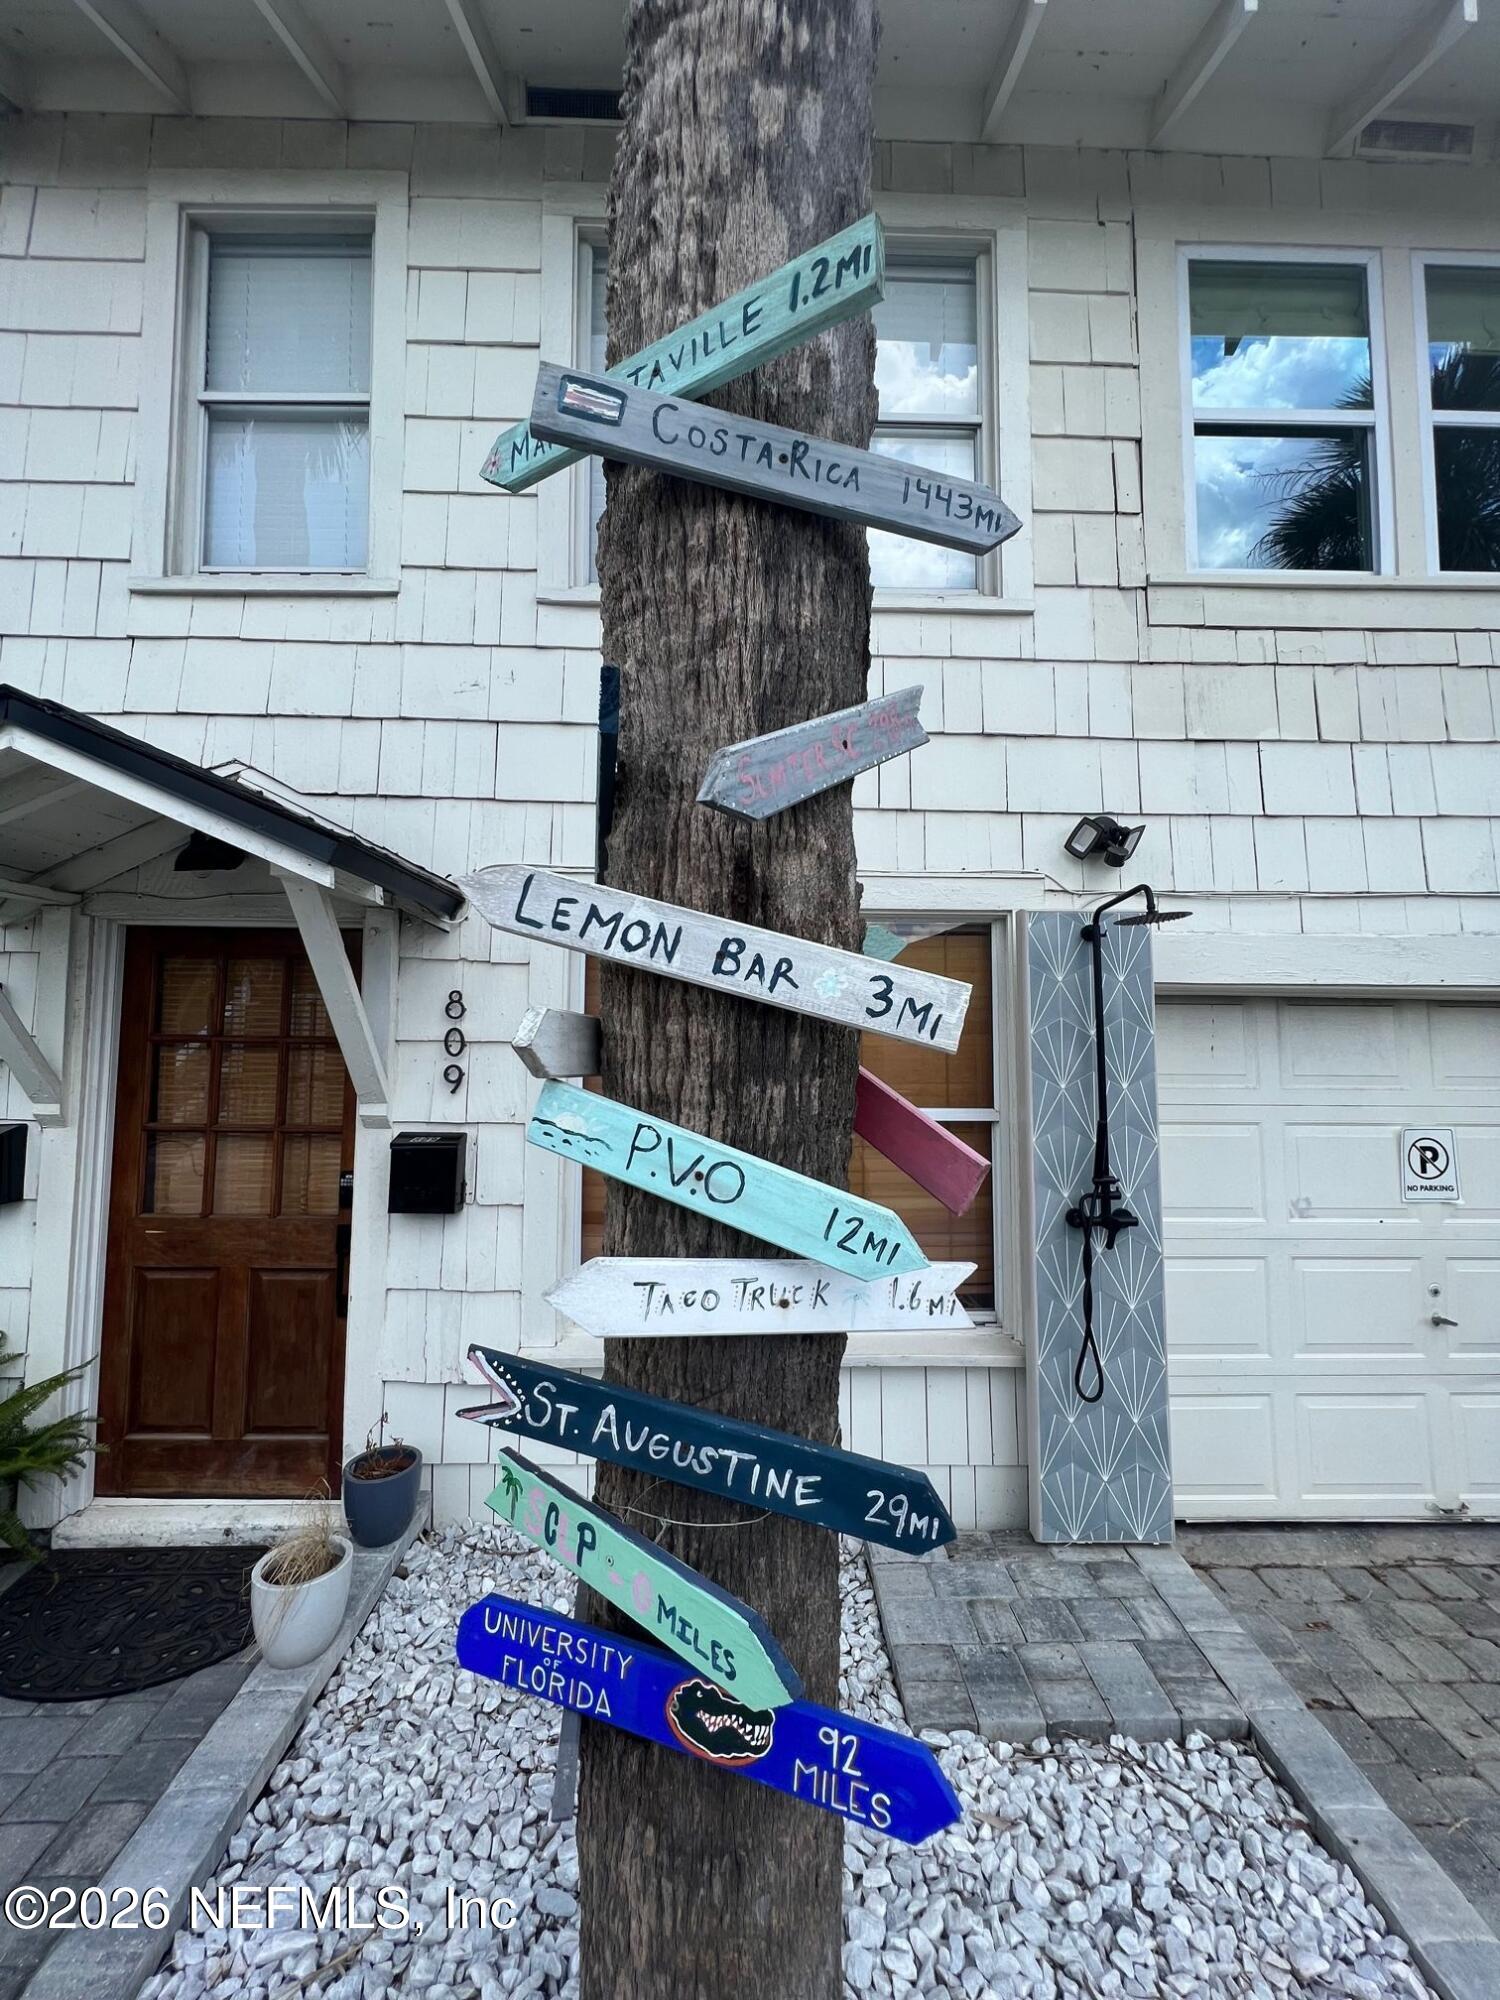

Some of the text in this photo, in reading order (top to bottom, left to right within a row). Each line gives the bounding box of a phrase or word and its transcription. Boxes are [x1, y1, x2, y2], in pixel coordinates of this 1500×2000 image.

[651, 403, 774, 470] COSTA
[788, 438, 861, 492] RICA
[514, 873, 683, 964] LEMON
[711, 936, 799, 994] BAR
[444, 989, 467, 1094] 809
[1407, 1184, 1455, 1192] NO PARKING
[633, 1280, 721, 1322] TACO
[730, 1276, 831, 1313] TRUCK
[524, 1380, 580, 1437] ST.
[591, 1403, 824, 1507] AUGUSTINE
[484, 1606, 633, 1680] UNIVERSITY
[543, 1656, 562, 1670] OF
[656, 1593, 737, 1682] MILES
[502, 1654, 612, 1718] FLORIDA
[818, 1726, 862, 1777] 92
[793, 1758, 892, 1829] MILES
